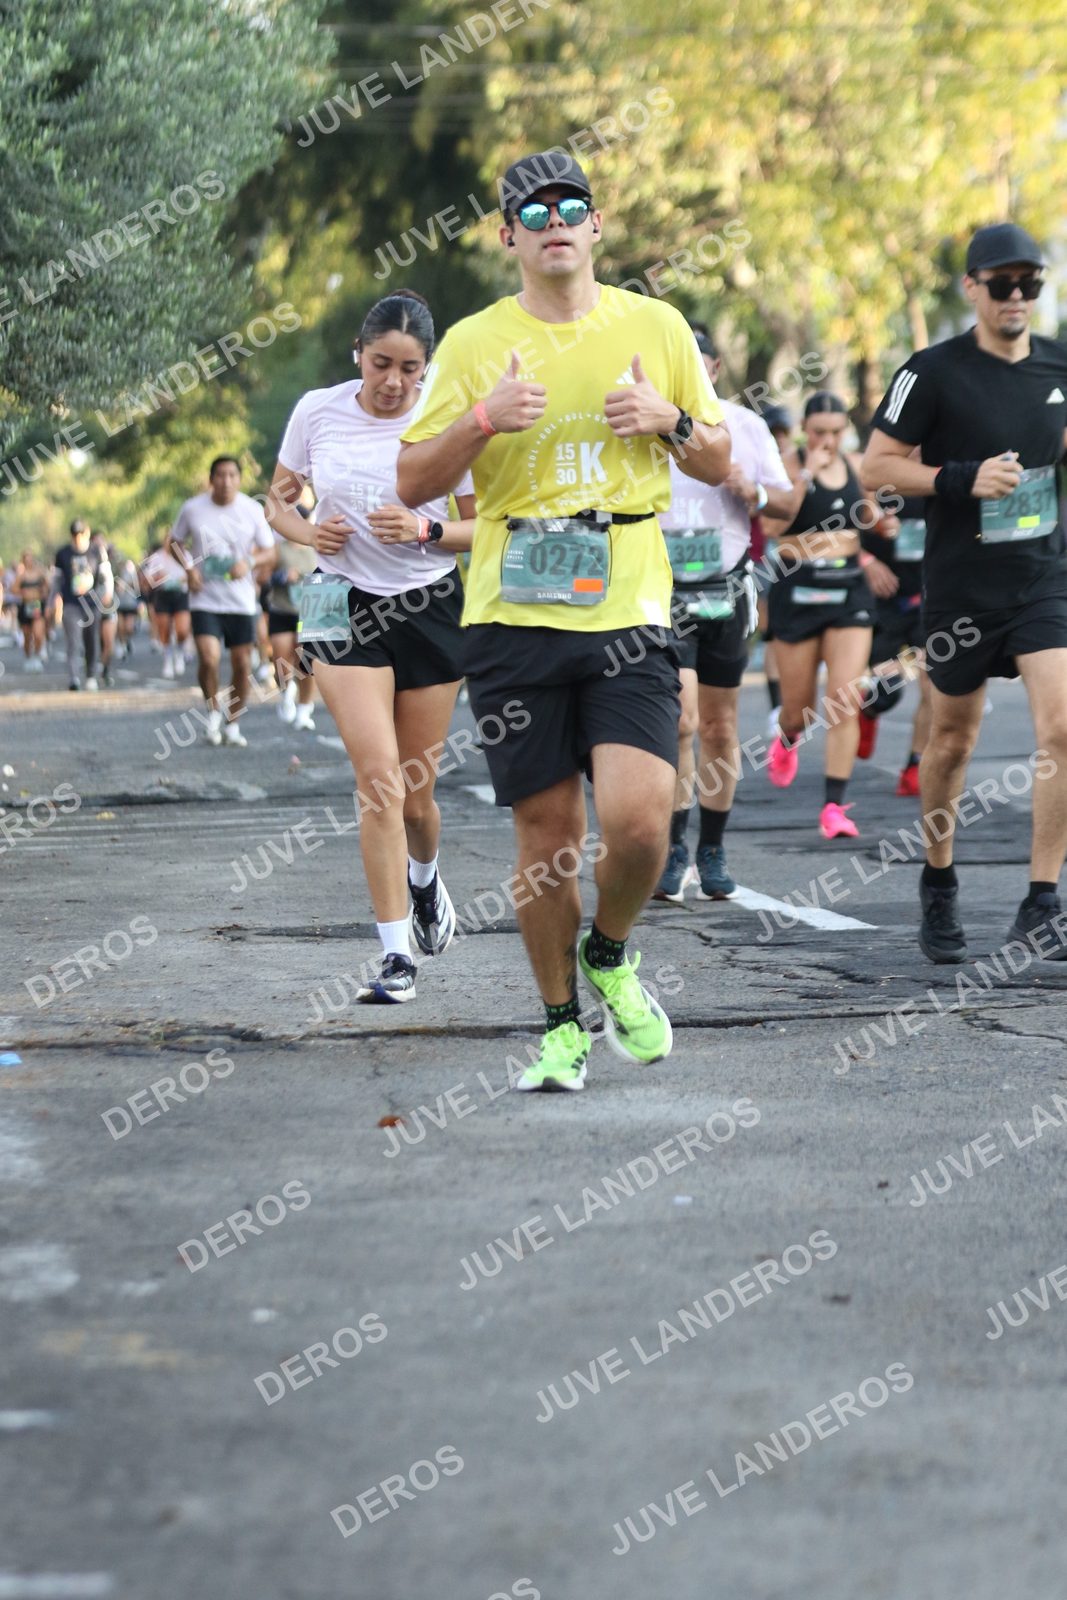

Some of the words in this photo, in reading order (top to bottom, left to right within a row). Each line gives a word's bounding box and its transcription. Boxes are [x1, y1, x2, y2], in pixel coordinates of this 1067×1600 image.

[555, 443, 576, 460] 15
[580, 441, 607, 484] K
[350, 483, 364, 496] 15
[556, 468, 577, 485] 30
[367, 485, 385, 513] K
[688, 498, 705, 526] K
[1003, 487, 1055, 519] 2837
[530, 544, 605, 577] 0272
[674, 543, 720, 564] 3210
[301, 591, 346, 620] 0744
